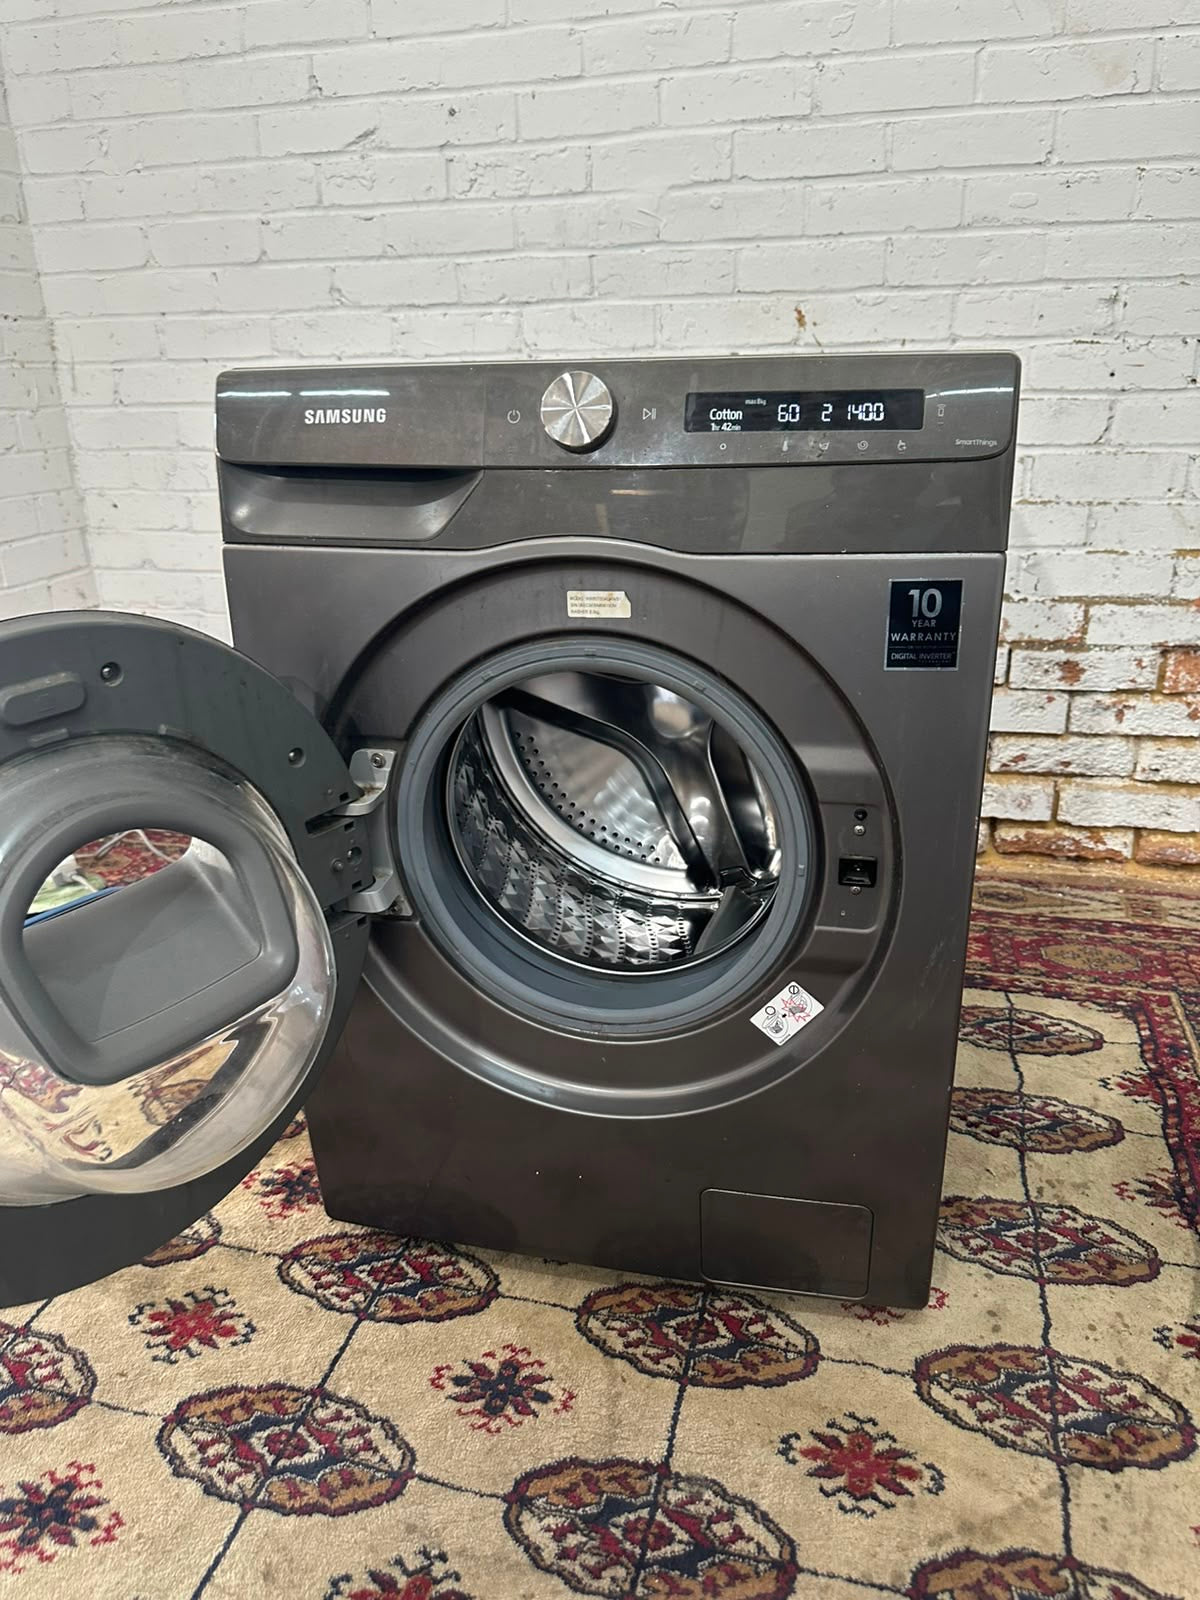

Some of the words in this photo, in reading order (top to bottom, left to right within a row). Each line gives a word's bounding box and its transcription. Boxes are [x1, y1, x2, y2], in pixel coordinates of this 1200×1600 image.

[304, 408, 387, 424] SAMSUNG
[709, 408, 743, 420] Cotton
[777, 404, 800, 422] 60
[821, 403, 833, 421] 2
[847, 402, 885, 421] 1400
[955, 439, 998, 447] SmartThings
[908, 588, 943, 618] 10
[911, 620, 937, 628] YEAR
[890, 632, 957, 641] WARRANTY
[890, 652, 917, 661] DIGITAL
